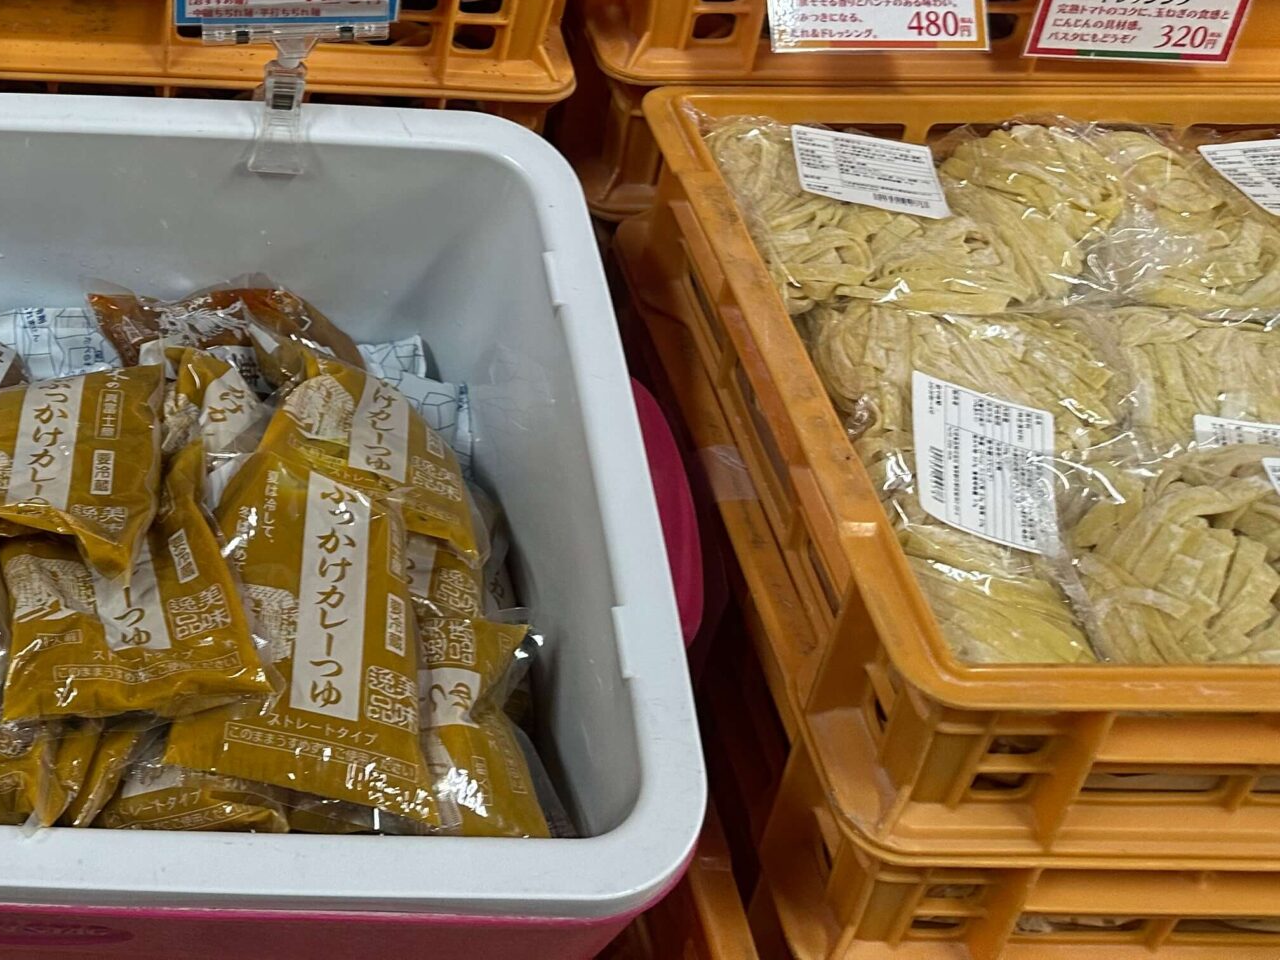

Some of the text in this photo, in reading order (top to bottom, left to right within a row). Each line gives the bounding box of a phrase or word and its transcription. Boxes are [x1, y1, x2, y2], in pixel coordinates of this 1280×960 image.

[310, 486, 358, 708] ぶっかけカレーつゆ
[269, 713, 379, 746] ストレートタイプ
